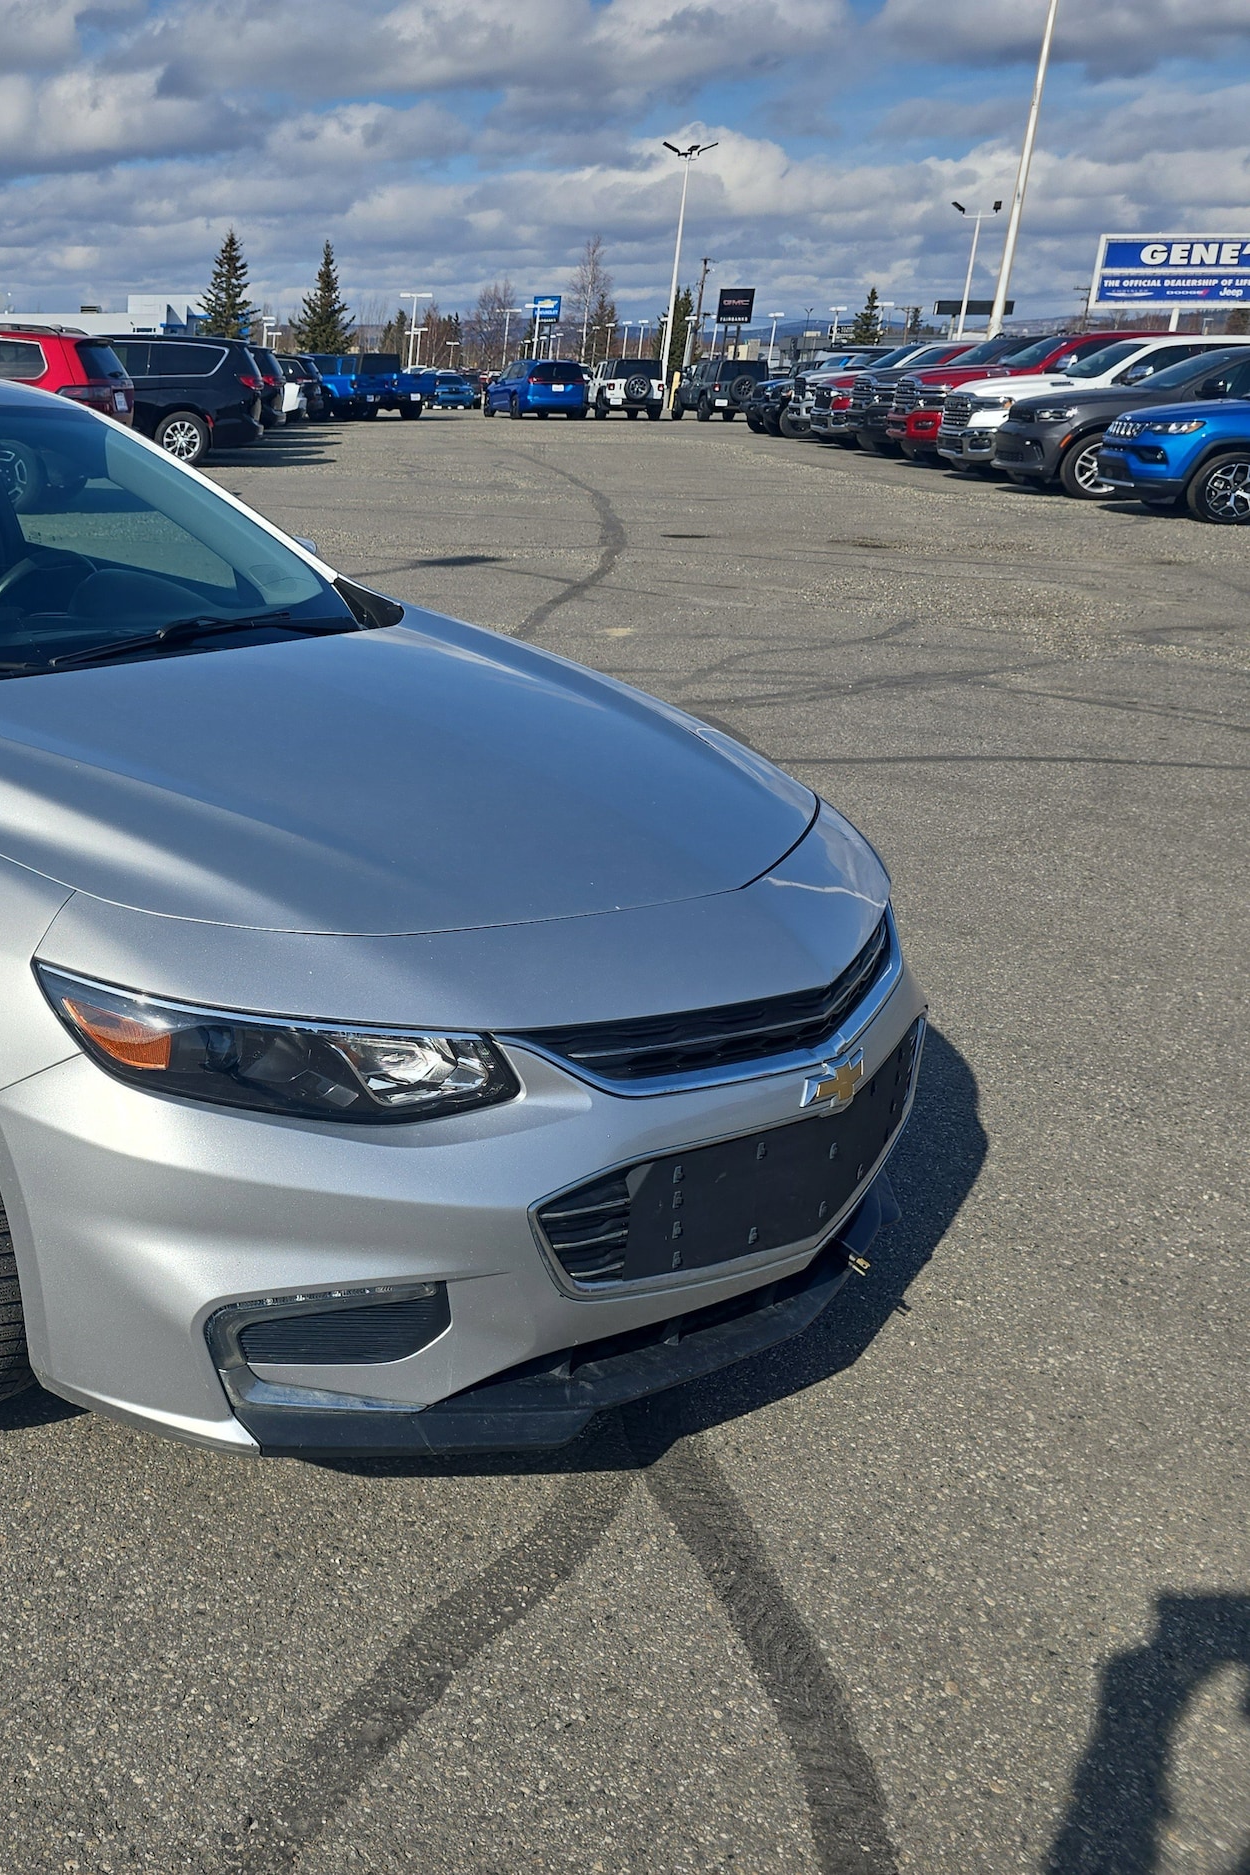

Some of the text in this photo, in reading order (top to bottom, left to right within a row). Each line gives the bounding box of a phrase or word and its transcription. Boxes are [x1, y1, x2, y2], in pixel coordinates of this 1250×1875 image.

[1103, 279, 1120, 287] THE
[1122, 279, 1161, 287] OFFICIAL
[1163, 279, 1219, 287] DEALERSHIP
[1220, 279, 1234, 287] OF
[1219, 287, 1243, 297] Jeep
